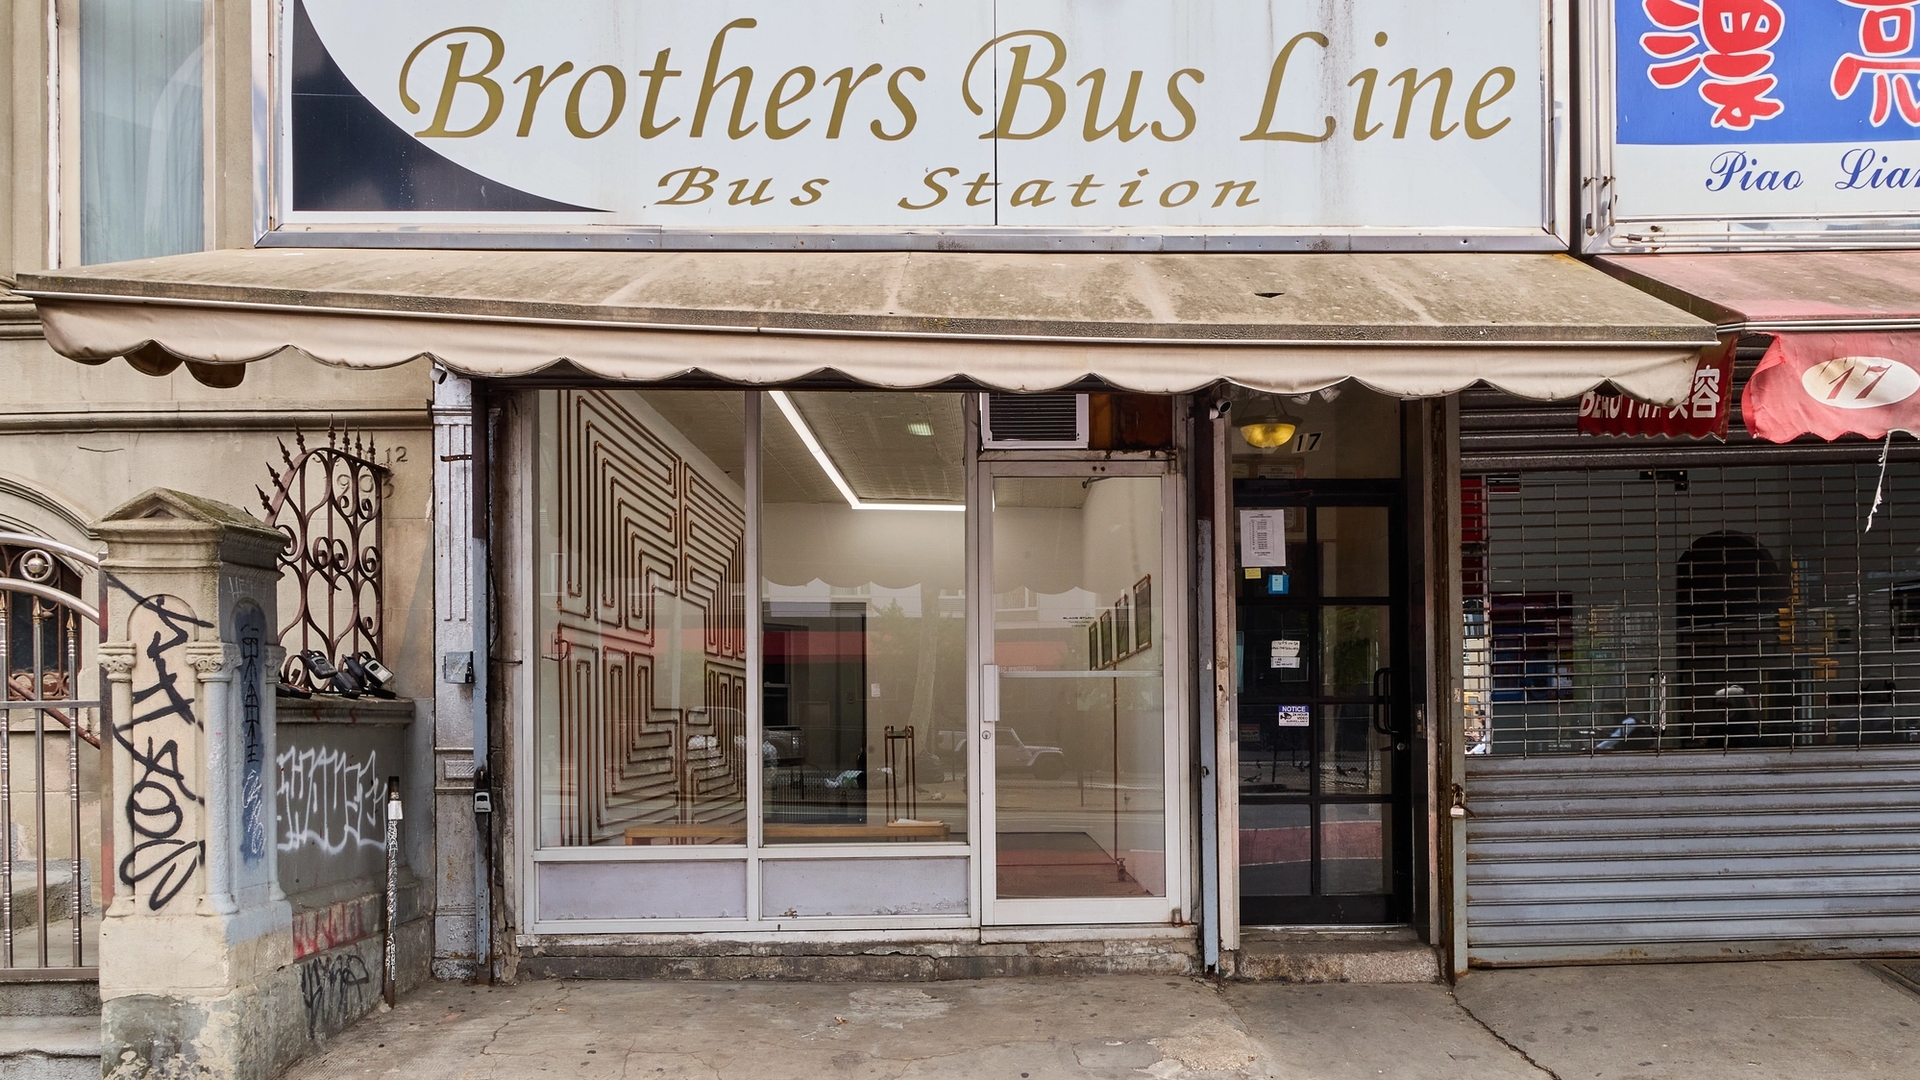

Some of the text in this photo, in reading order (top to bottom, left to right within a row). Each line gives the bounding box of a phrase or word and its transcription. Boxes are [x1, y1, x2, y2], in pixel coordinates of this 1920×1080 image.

[399, 18, 1516, 143] Brothers Bus Line
[1705, 148, 1920, 191] Piao Lia
[654, 165, 1260, 210] Bus Station
[1826, 364, 1893, 400] 17
[384, 446, 408, 465] 12
[1297, 432, 1322, 452] 17
[322, 473, 396, 500] 903
[1282, 705, 1306, 713] NOTICE
